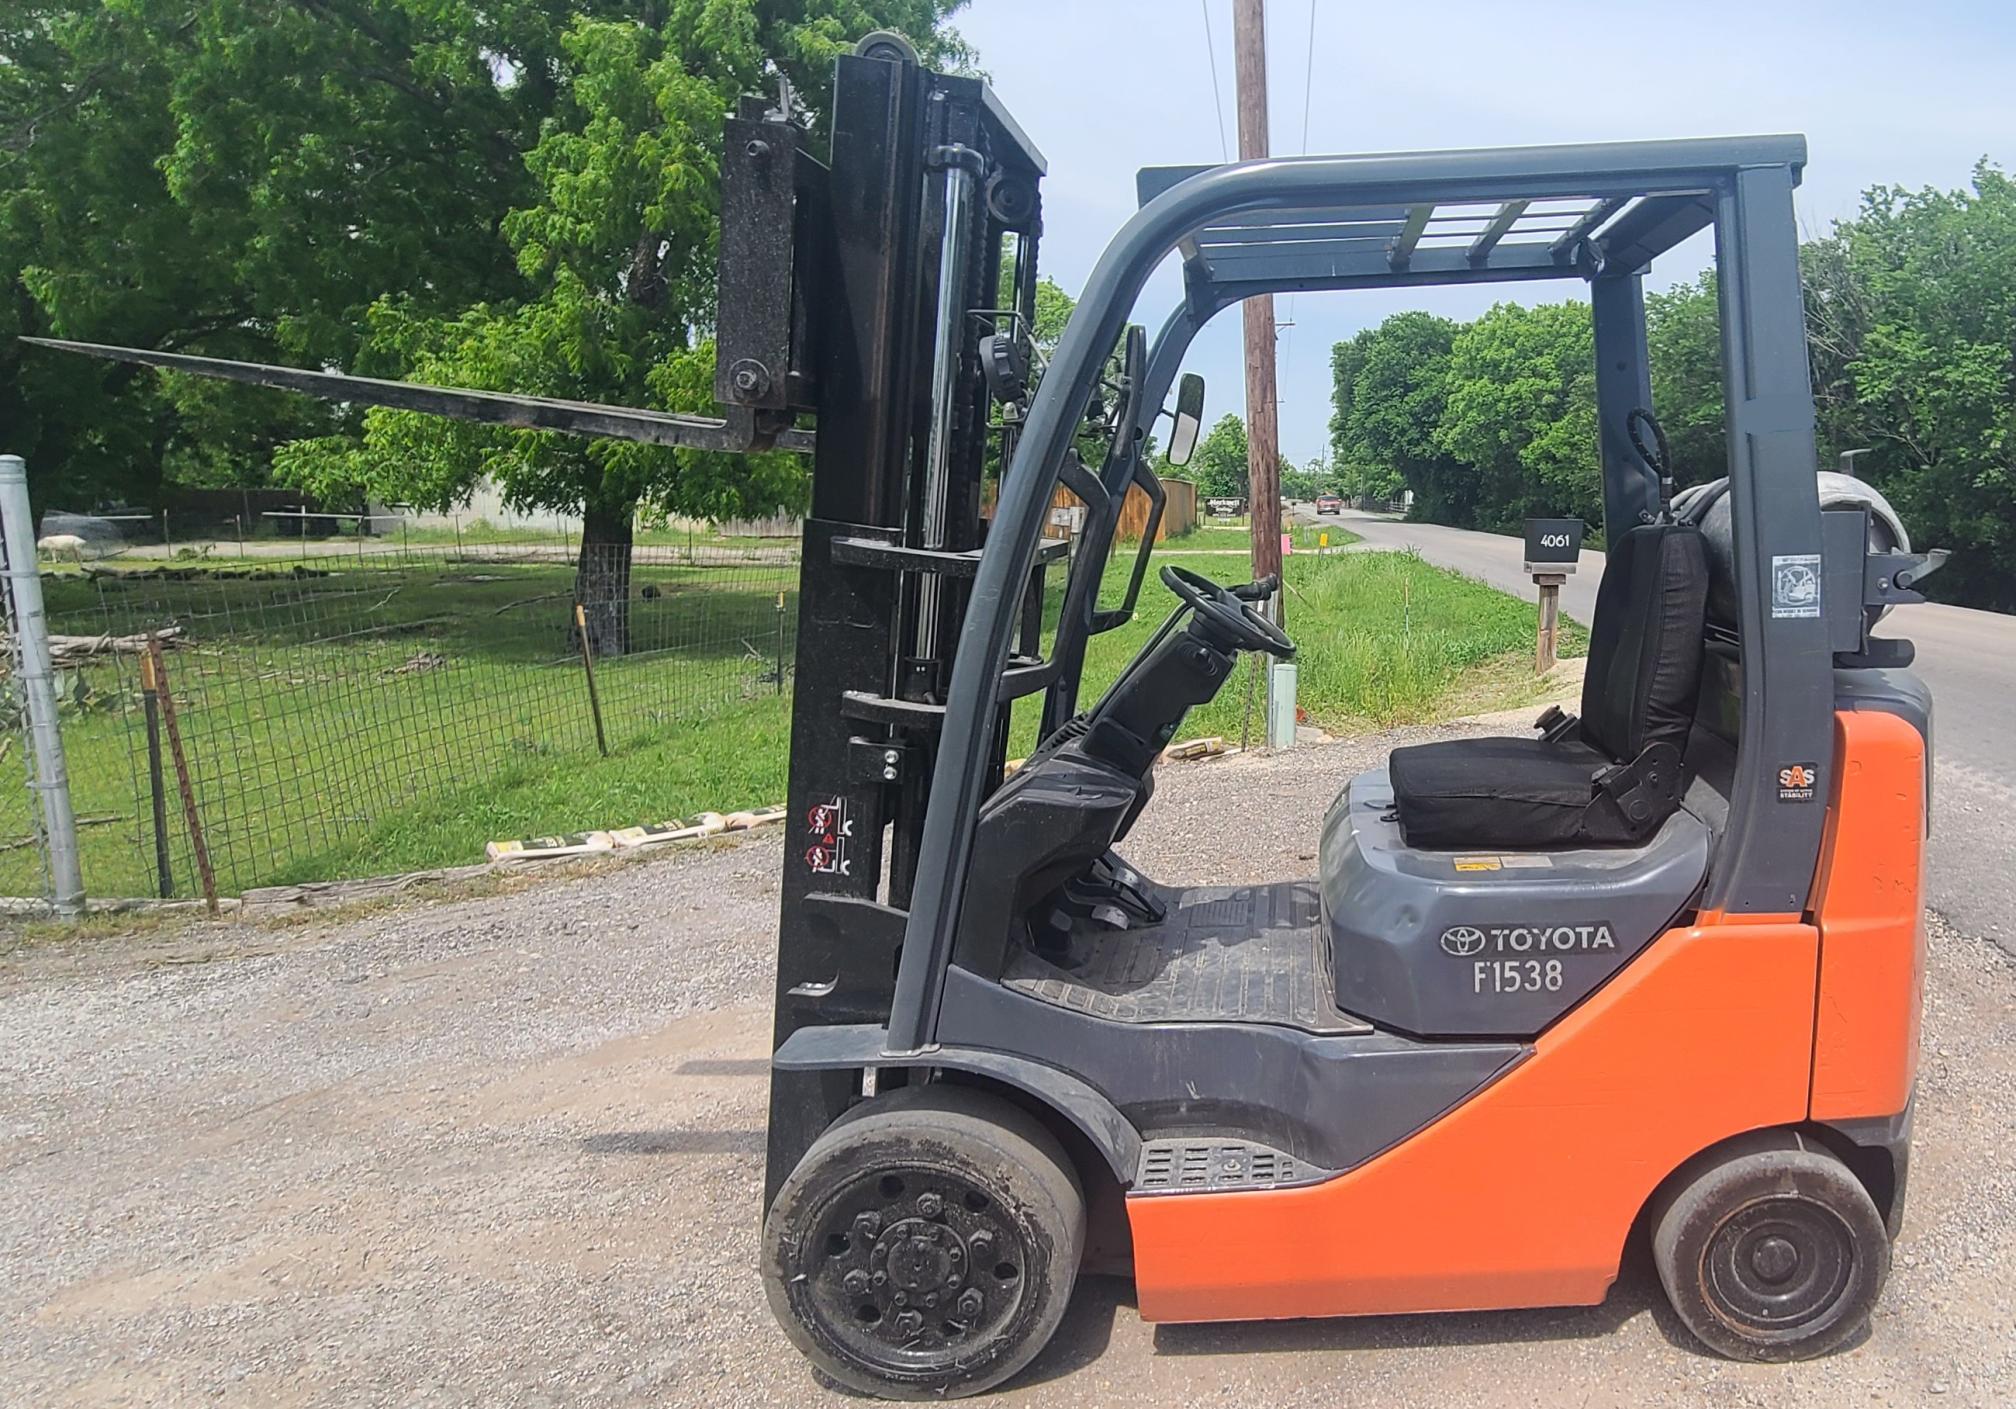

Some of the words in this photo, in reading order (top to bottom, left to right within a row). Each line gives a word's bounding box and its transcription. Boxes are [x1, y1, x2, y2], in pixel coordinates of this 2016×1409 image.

[1541, 534, 1570, 547] 4061
[1780, 766, 1815, 787] SAS
[1491, 926, 1615, 951] TOYOTA
[1474, 960, 1563, 993] F1538
